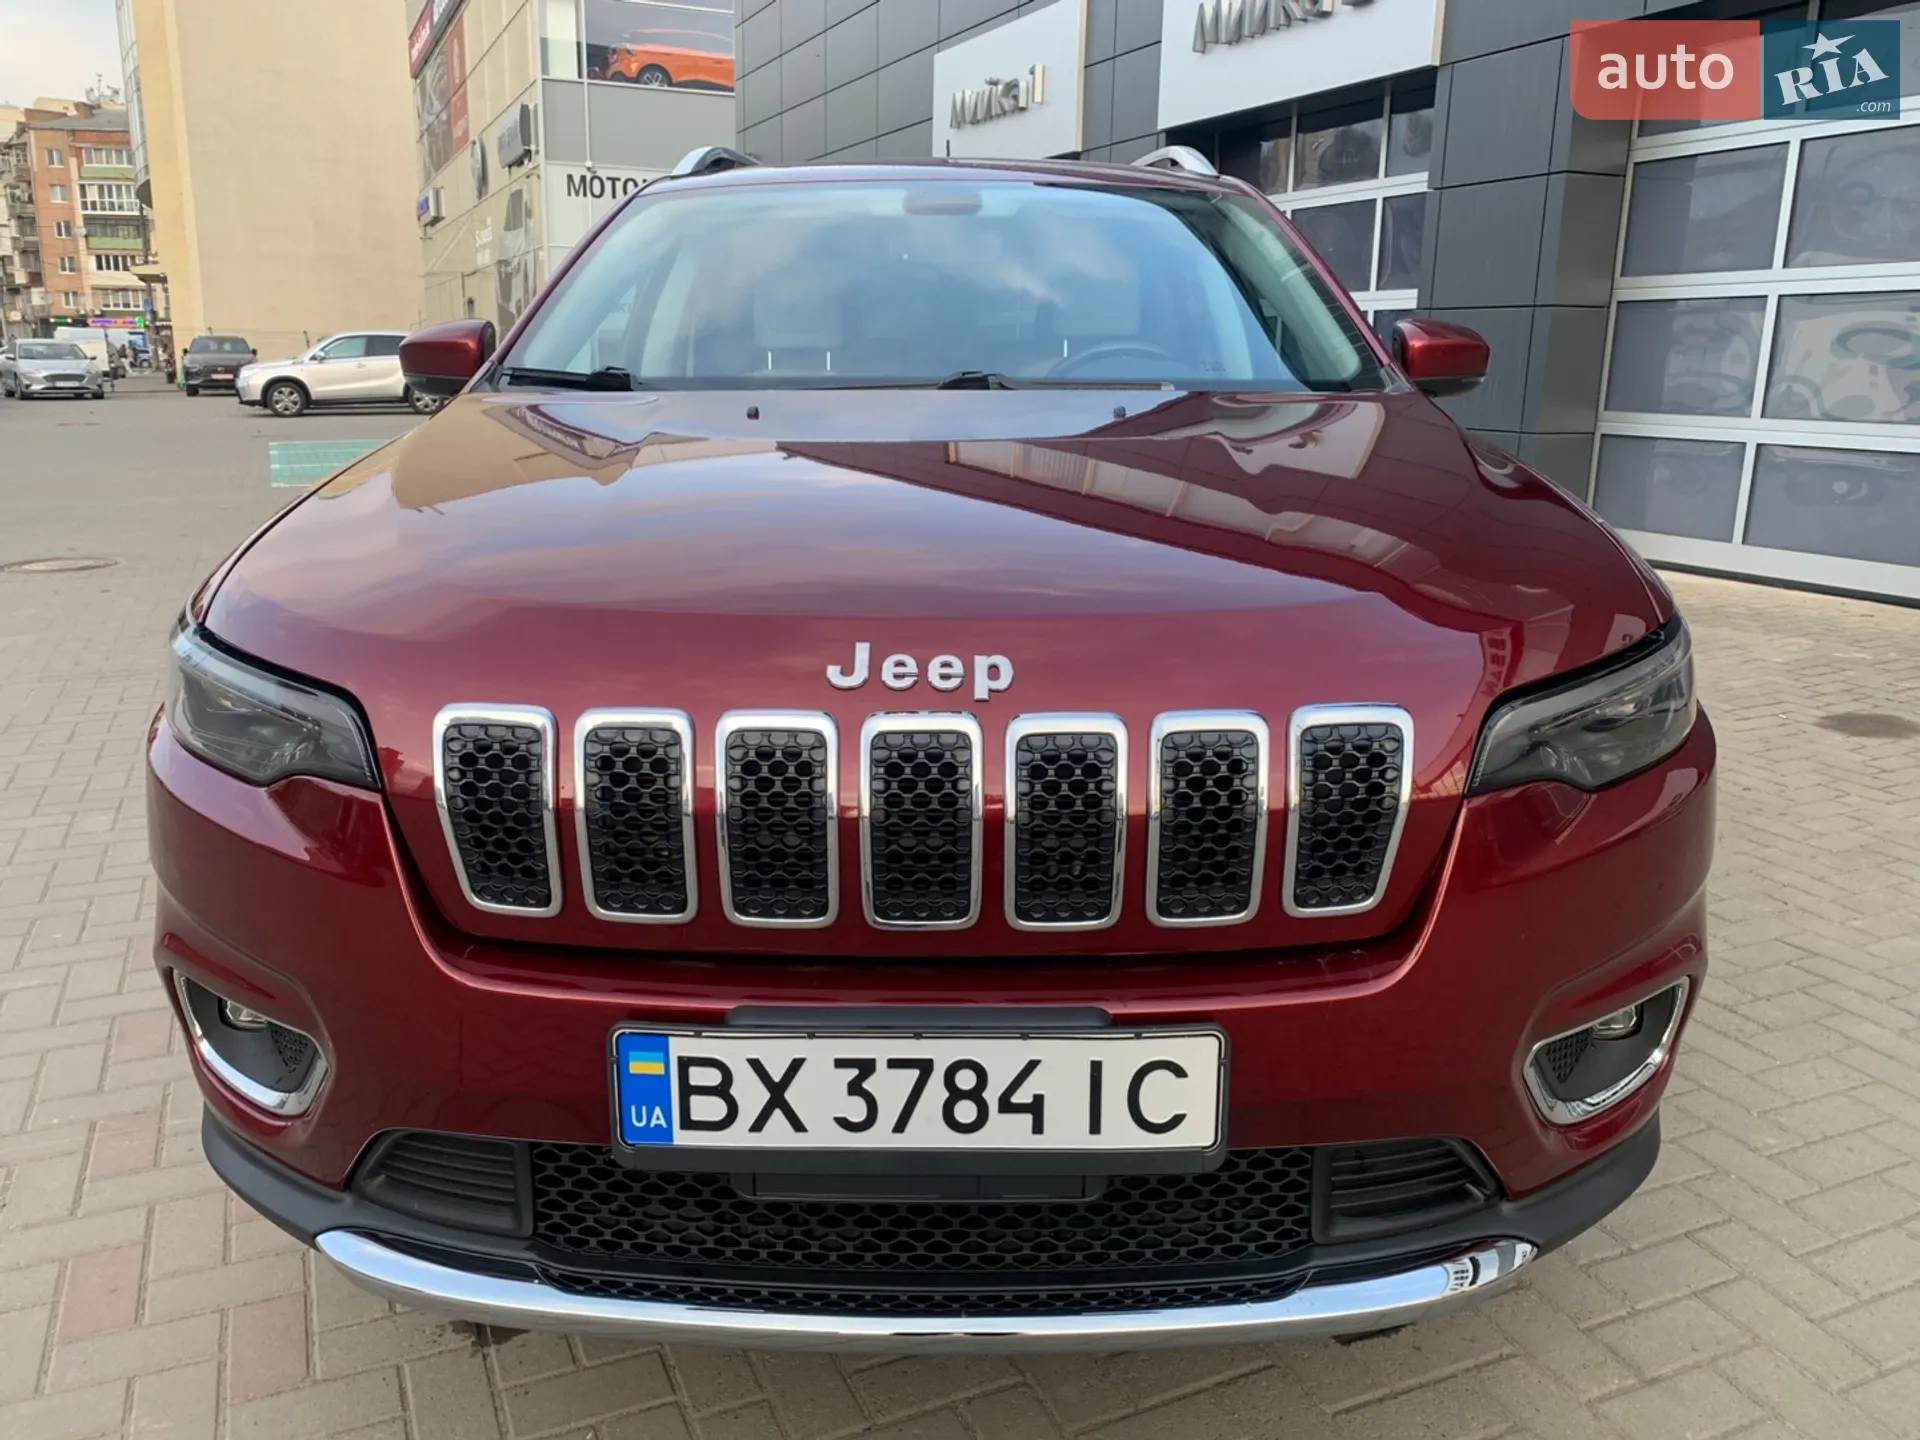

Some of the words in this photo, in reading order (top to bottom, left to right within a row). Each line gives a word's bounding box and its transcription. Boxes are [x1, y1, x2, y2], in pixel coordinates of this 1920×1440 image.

[826, 642, 1014, 702] Jeep
[631, 1105, 667, 1129] UA
[677, 1055, 808, 1133] BX
[832, 1057, 1045, 1136] 3784
[1089, 1059, 1189, 1136] IC
